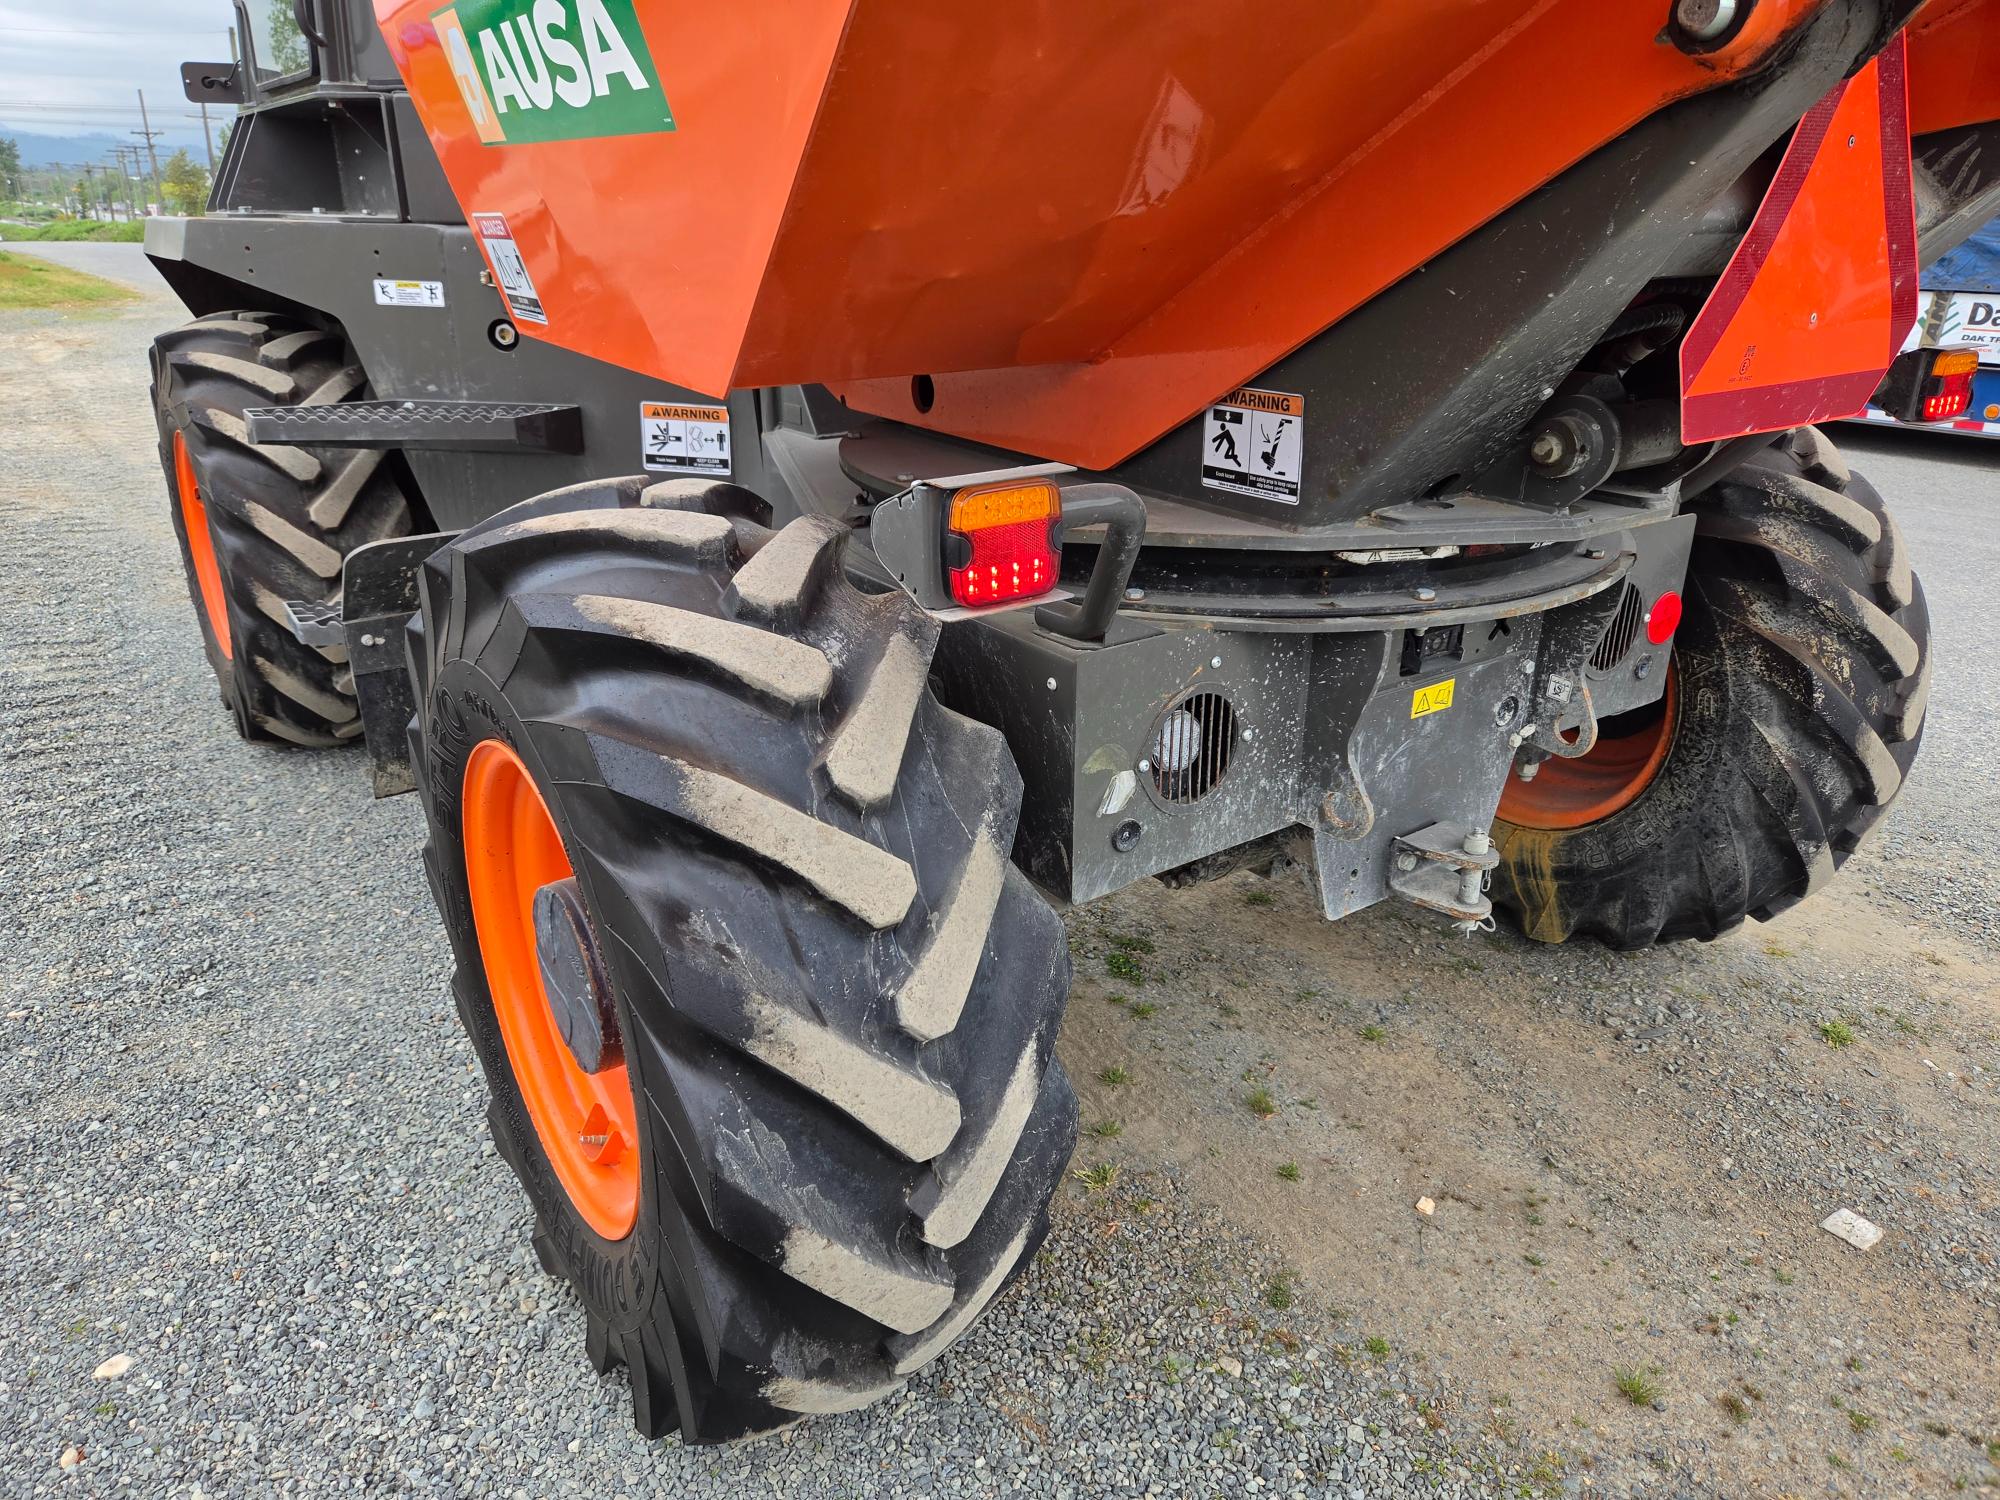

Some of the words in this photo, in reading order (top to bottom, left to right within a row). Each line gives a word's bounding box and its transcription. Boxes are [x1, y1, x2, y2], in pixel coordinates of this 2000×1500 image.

[478, 0, 650, 114] AUSA
[1961, 334, 1985, 342] DAK
[1228, 391, 1290, 412] WARNING
[661, 407, 720, 420] WARNING
